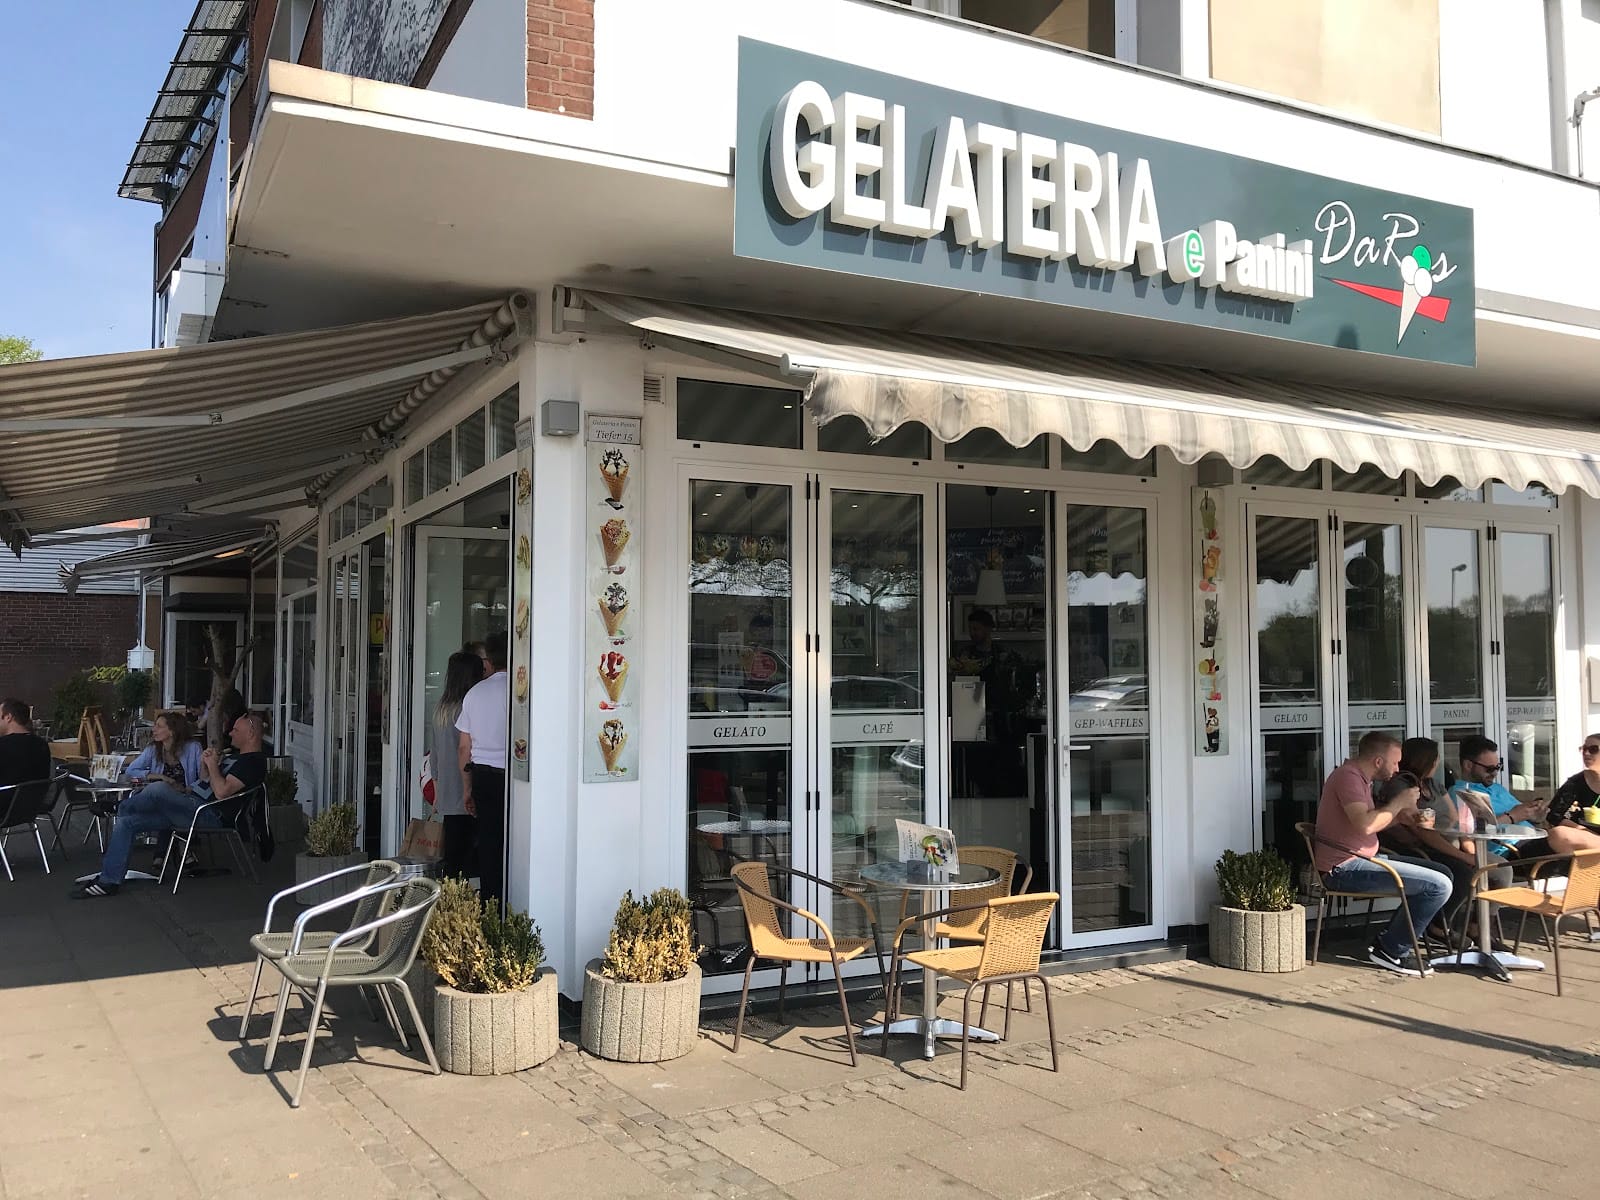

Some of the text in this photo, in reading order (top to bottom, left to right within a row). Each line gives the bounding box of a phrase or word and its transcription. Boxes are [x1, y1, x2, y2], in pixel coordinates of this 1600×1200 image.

[773, 80, 1314, 300] GELATERIA e Panini
[595, 429, 633, 442] Tiefer 15
[1274, 713, 1308, 723] GELATO
[1366, 710, 1388, 721] CAFÉ
[1443, 709, 1470, 718] PANINI
[713, 726, 767, 738] GELATO
[862, 721, 894, 735] CAFÉ
